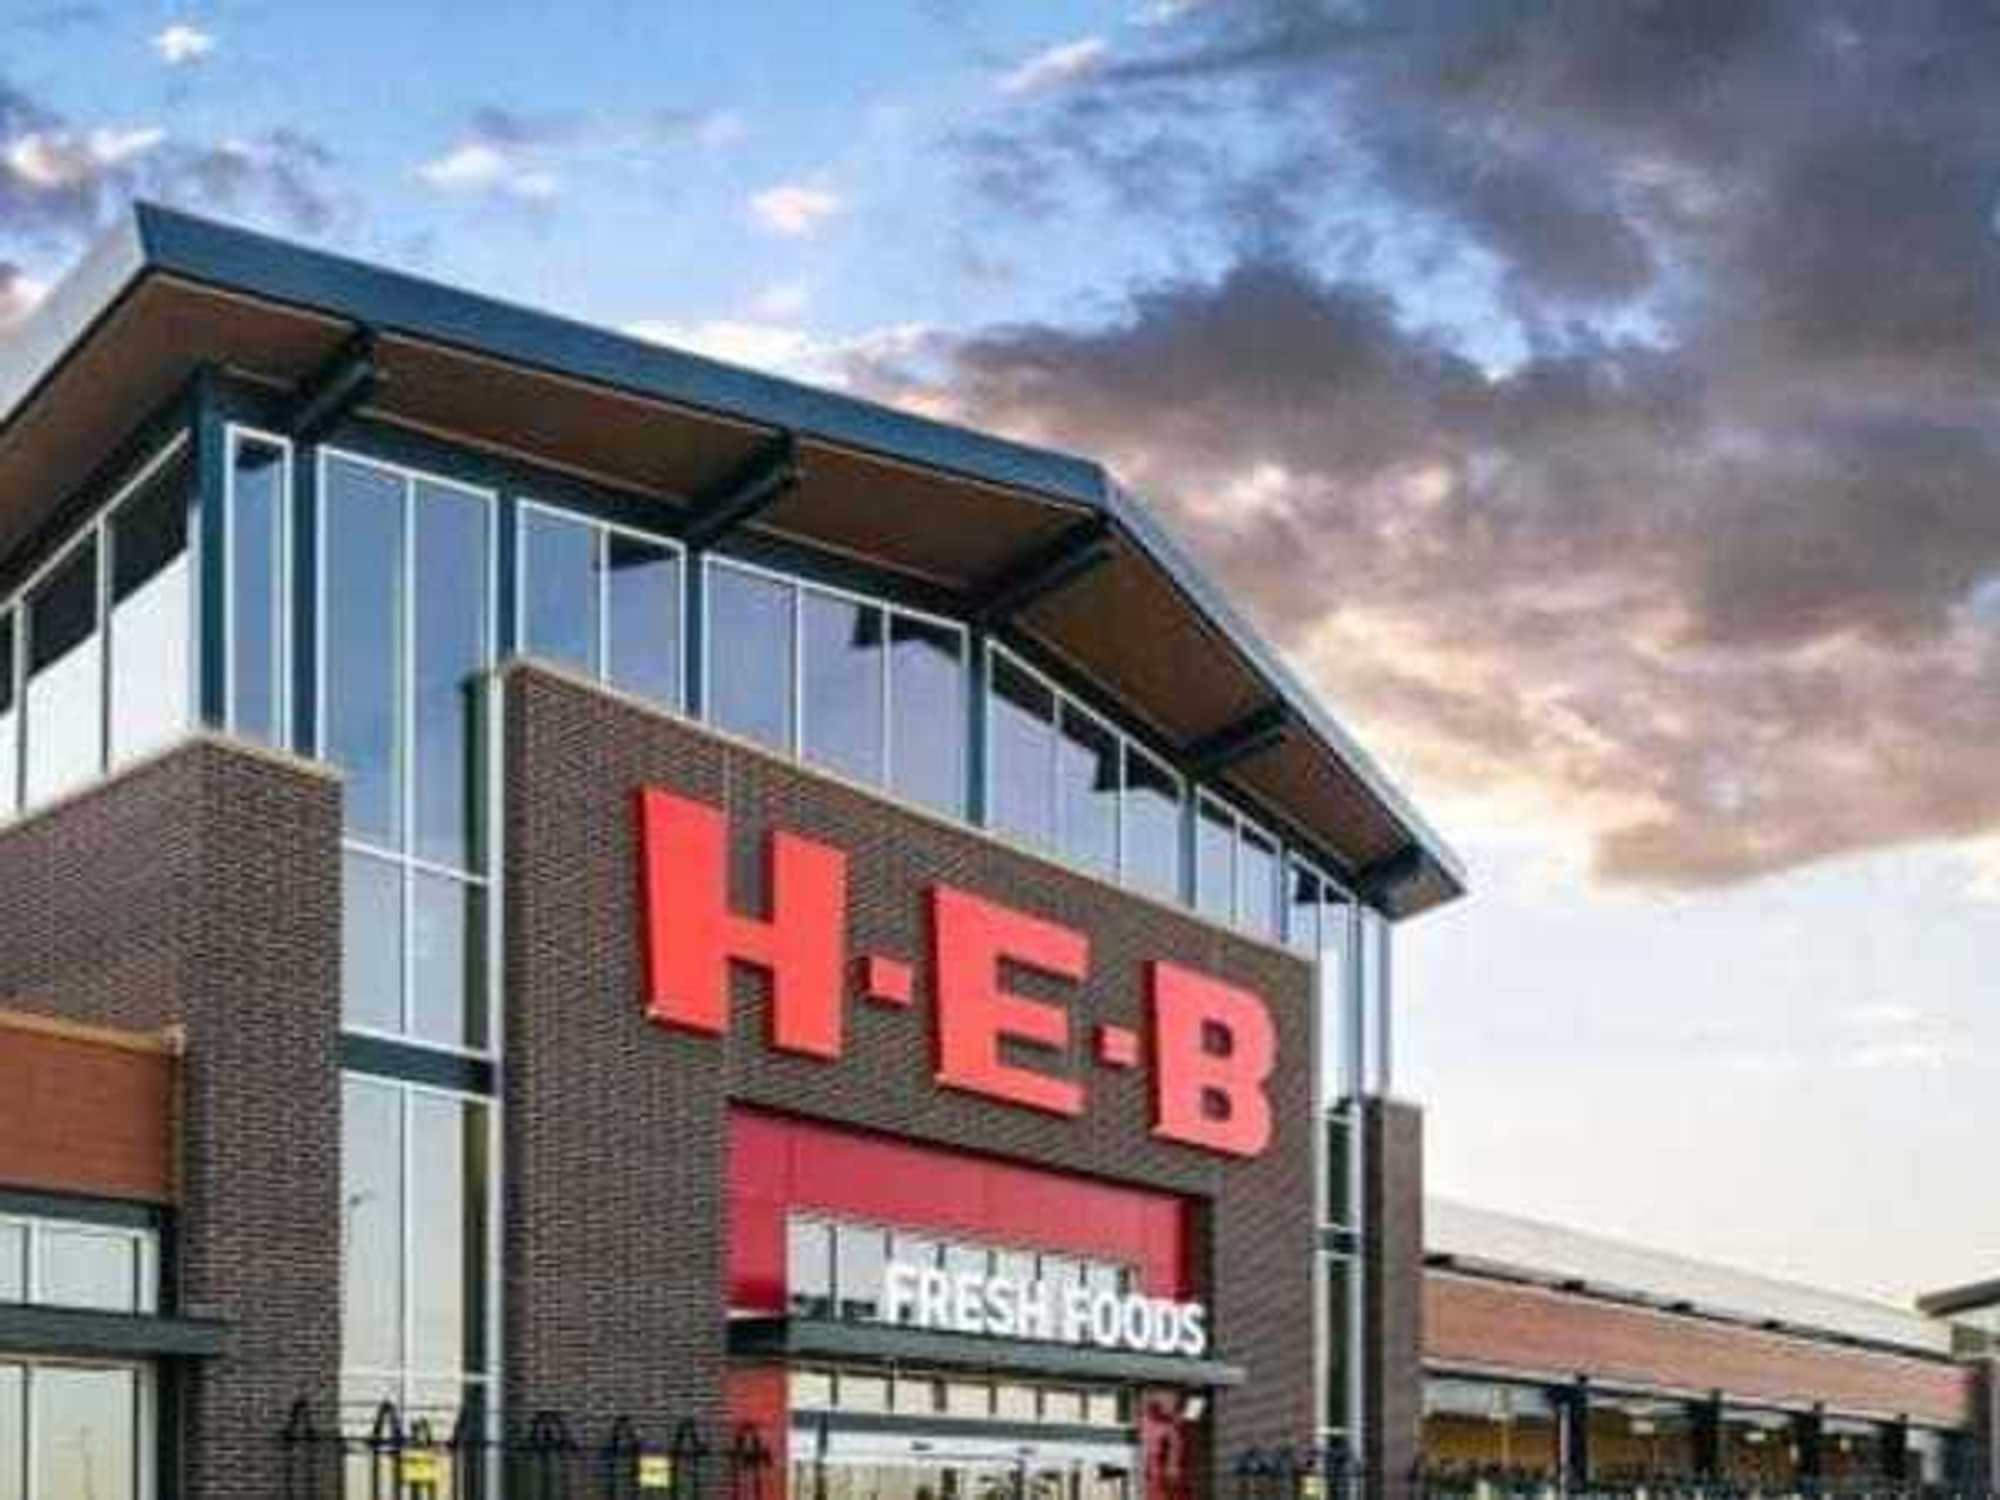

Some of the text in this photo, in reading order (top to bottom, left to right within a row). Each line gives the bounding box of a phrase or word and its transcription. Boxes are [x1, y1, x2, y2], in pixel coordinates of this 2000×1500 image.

[638, 786, 1277, 1157] H-E-B
[884, 1263, 1206, 1355] FRESH FOODS
